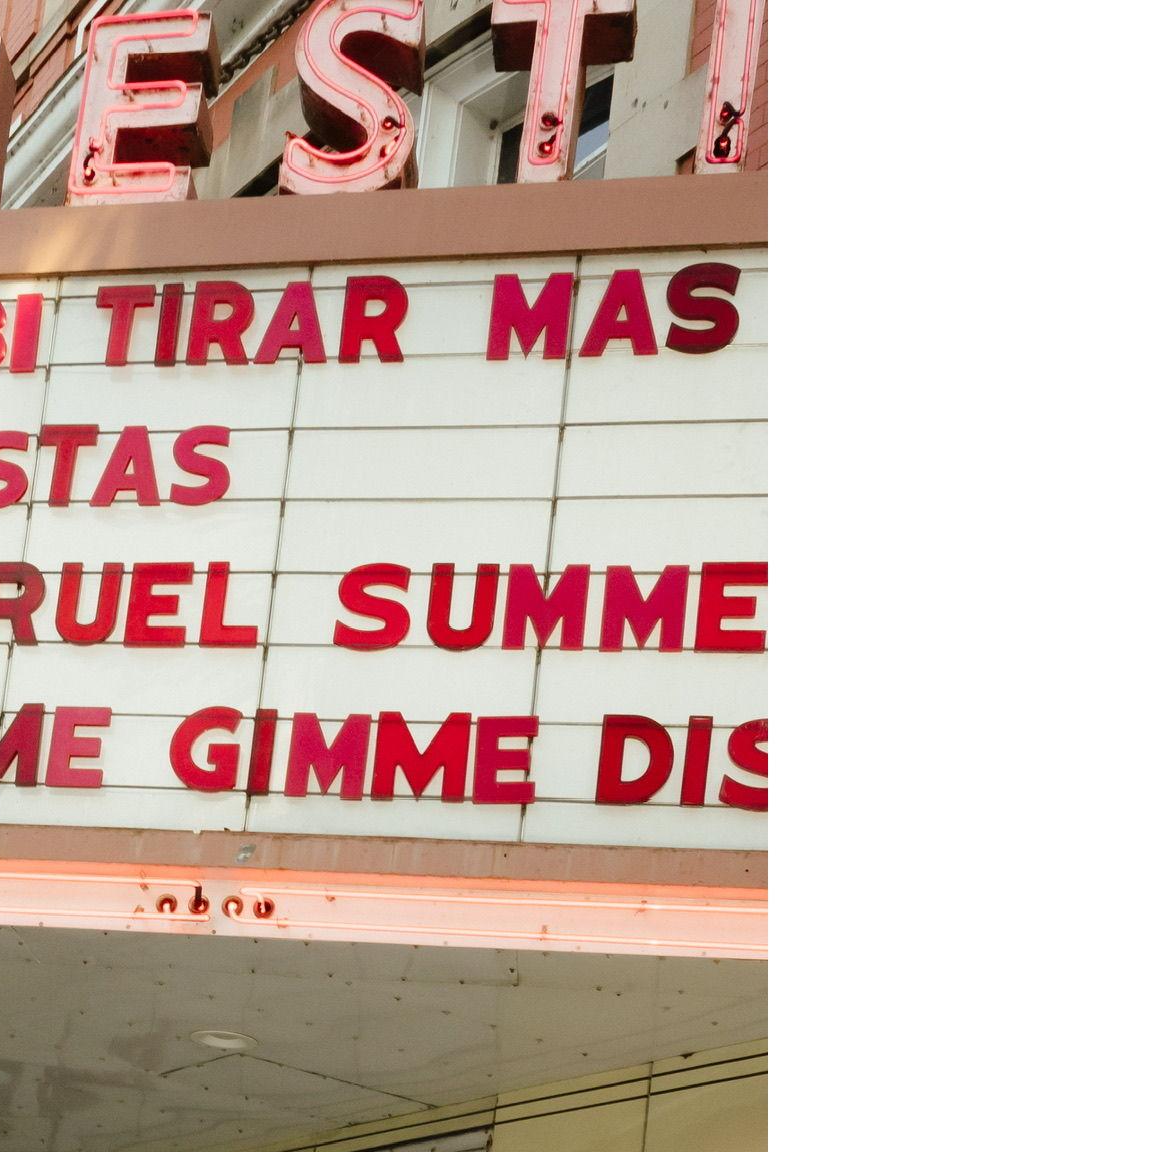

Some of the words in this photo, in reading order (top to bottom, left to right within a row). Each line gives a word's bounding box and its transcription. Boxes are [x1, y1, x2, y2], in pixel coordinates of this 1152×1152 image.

[96, 274, 410, 368] TIRAR
[486, 262, 742, 363] MAS
[333, 560, 768, 654] SUMME
[169, 705, 540, 806] GIMME
[595, 713, 768, 812] DIS
